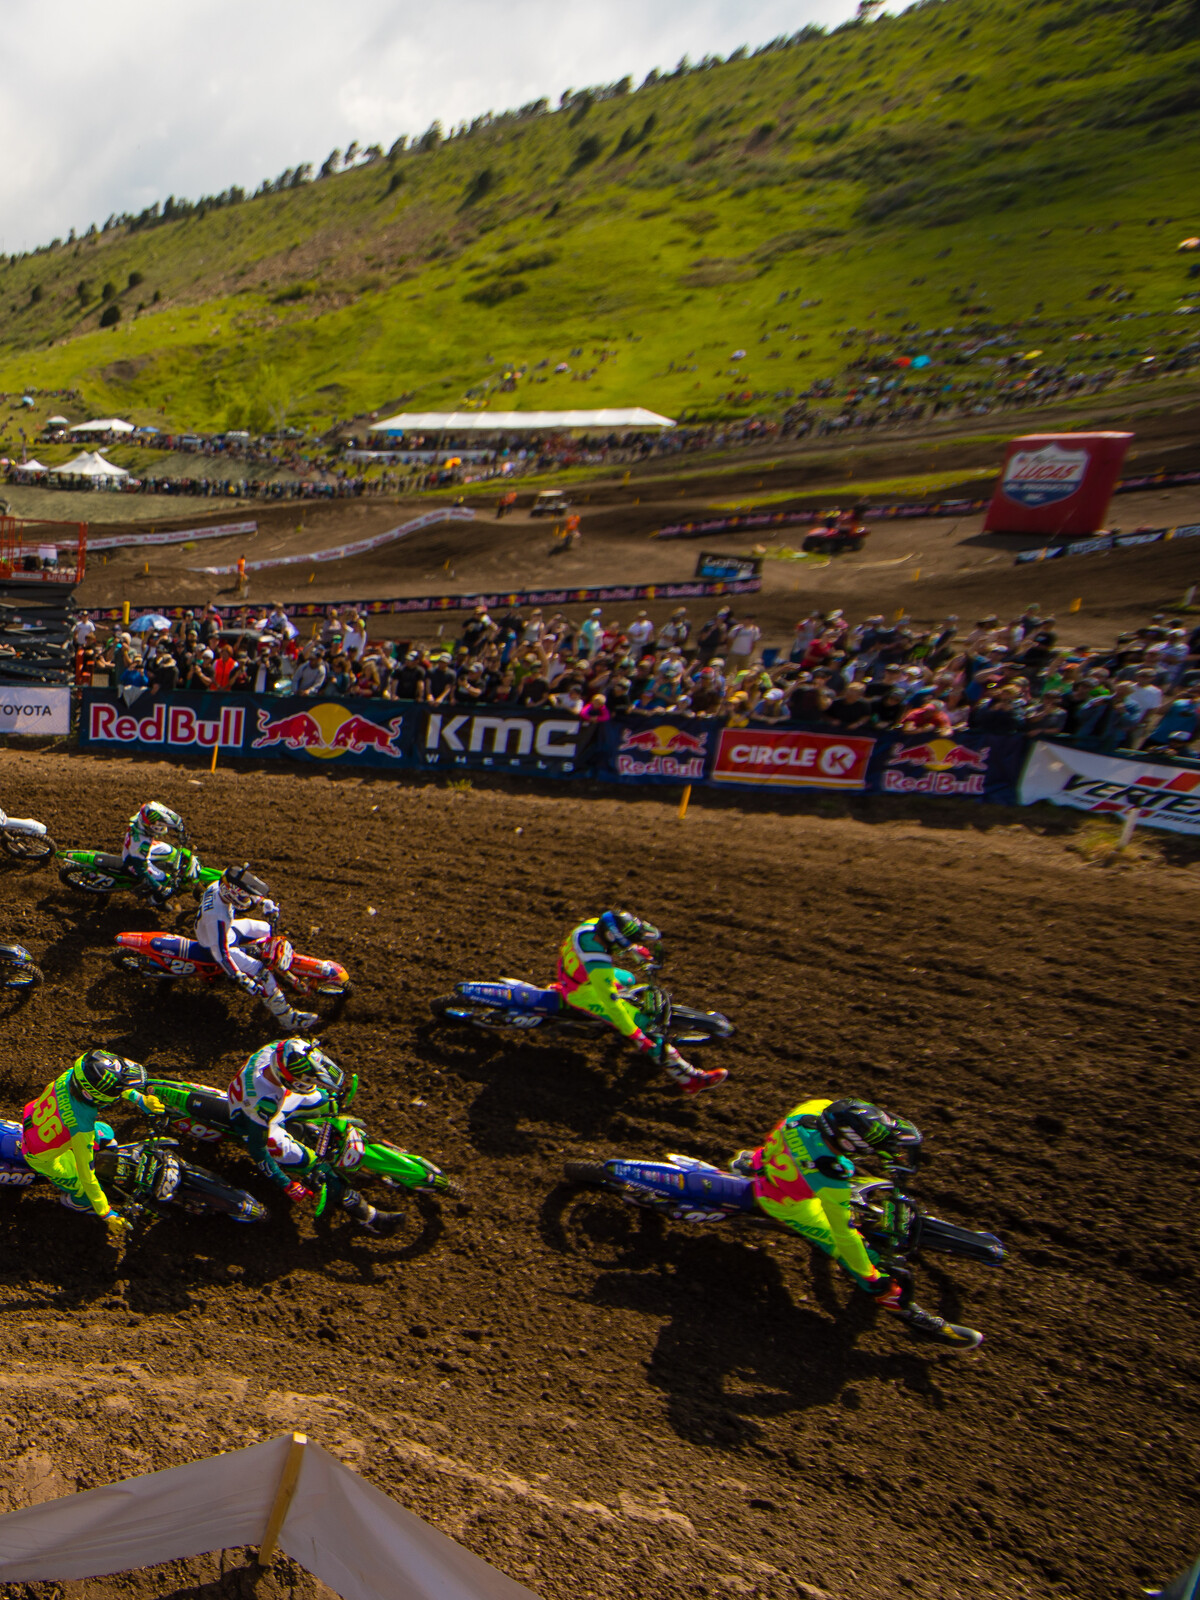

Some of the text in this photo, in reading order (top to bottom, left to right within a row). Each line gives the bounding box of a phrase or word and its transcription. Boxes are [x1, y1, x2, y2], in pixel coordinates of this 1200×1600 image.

[1011, 464, 1079, 480] LUCAS
[89, 703, 245, 747] Red Bull
[426, 713, 580, 758] KMC
[426, 754, 575, 771] WHEELS
[617, 755, 704, 779] Red Bull
[729, 744, 816, 767] CIRCLE
[884, 770, 985, 794] Red Bull
[1062, 773, 1200, 814] VERTE
[190, 1123, 222, 1140] 92
